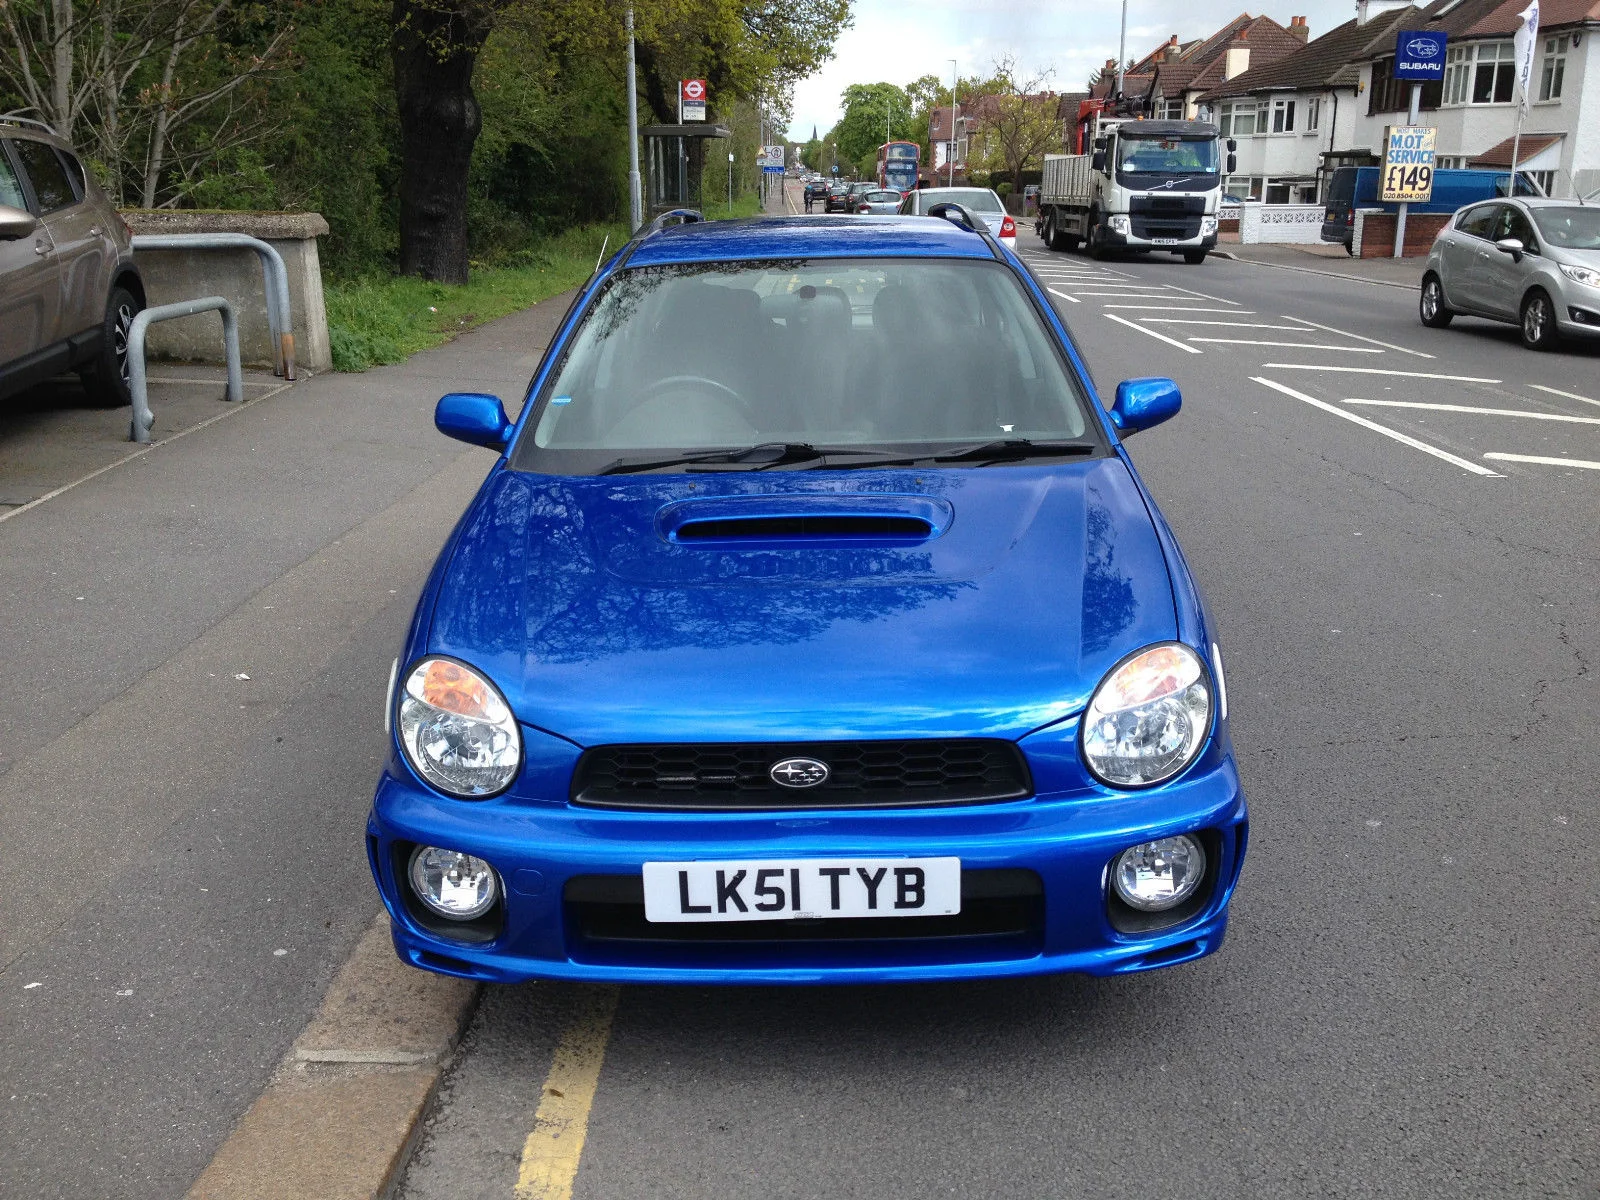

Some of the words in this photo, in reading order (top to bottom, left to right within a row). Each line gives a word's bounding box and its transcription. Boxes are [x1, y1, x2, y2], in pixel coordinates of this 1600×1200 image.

[1399, 62, 1441, 71] SUBARU
[1387, 150, 1434, 164] SERVICE
[1385, 166, 1431, 191] £149
[678, 868, 800, 914] LK51
[819, 867, 926, 910] TYB
